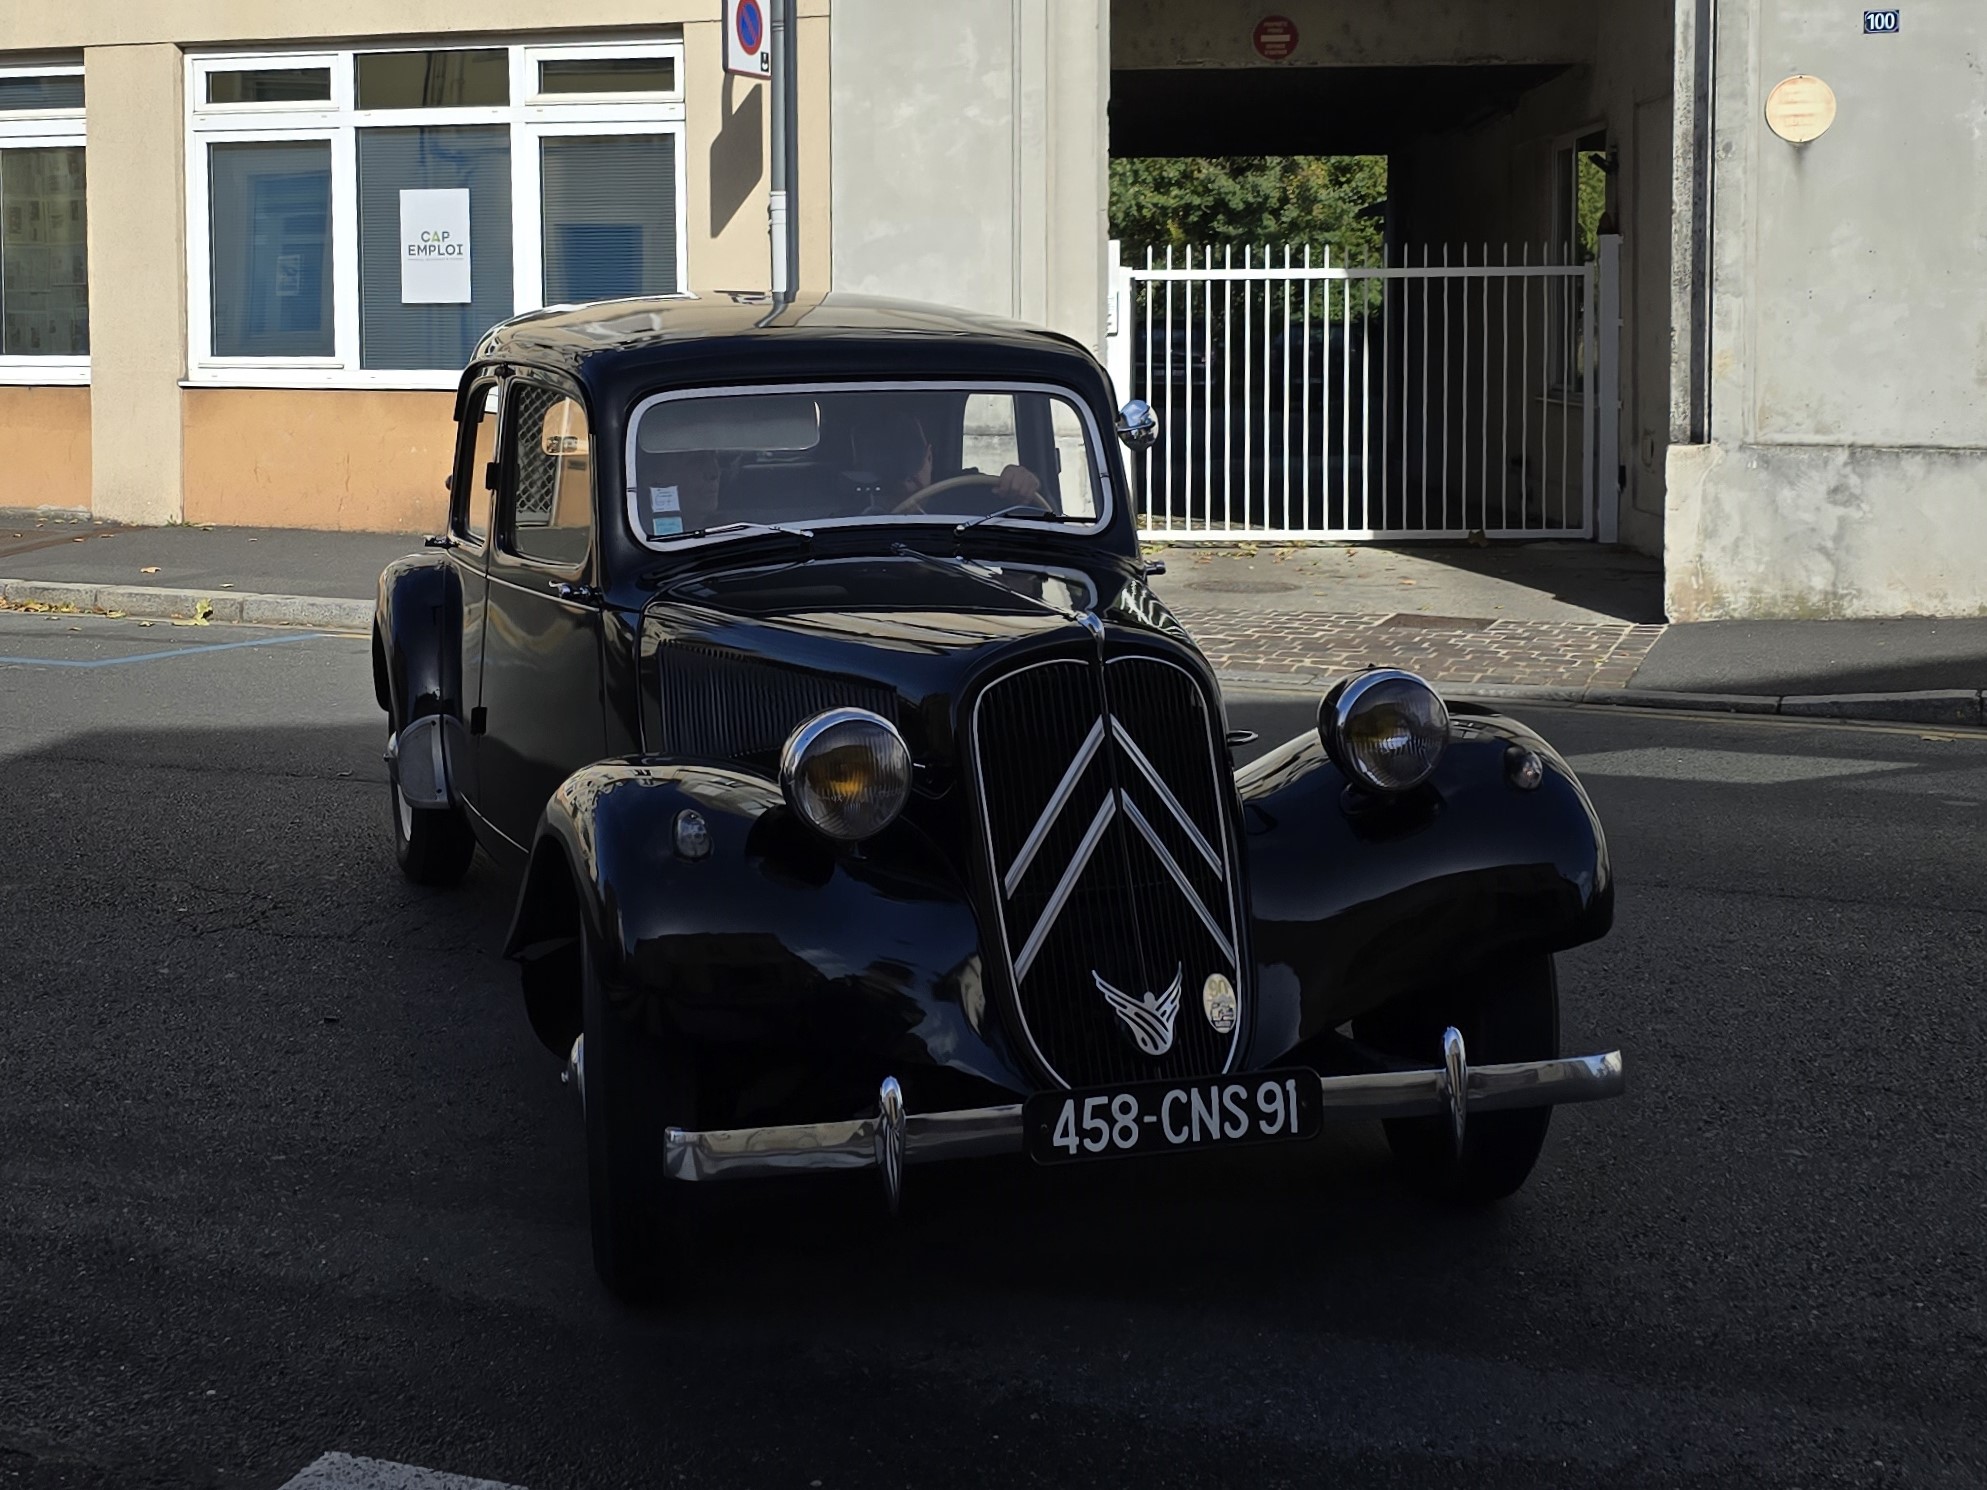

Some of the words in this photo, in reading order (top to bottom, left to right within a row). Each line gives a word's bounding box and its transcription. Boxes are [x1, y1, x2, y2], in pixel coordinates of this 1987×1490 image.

[1866, 12, 1895, 30] 100
[420, 230, 450, 243] CAP
[408, 244, 463, 256] EMPLOI
